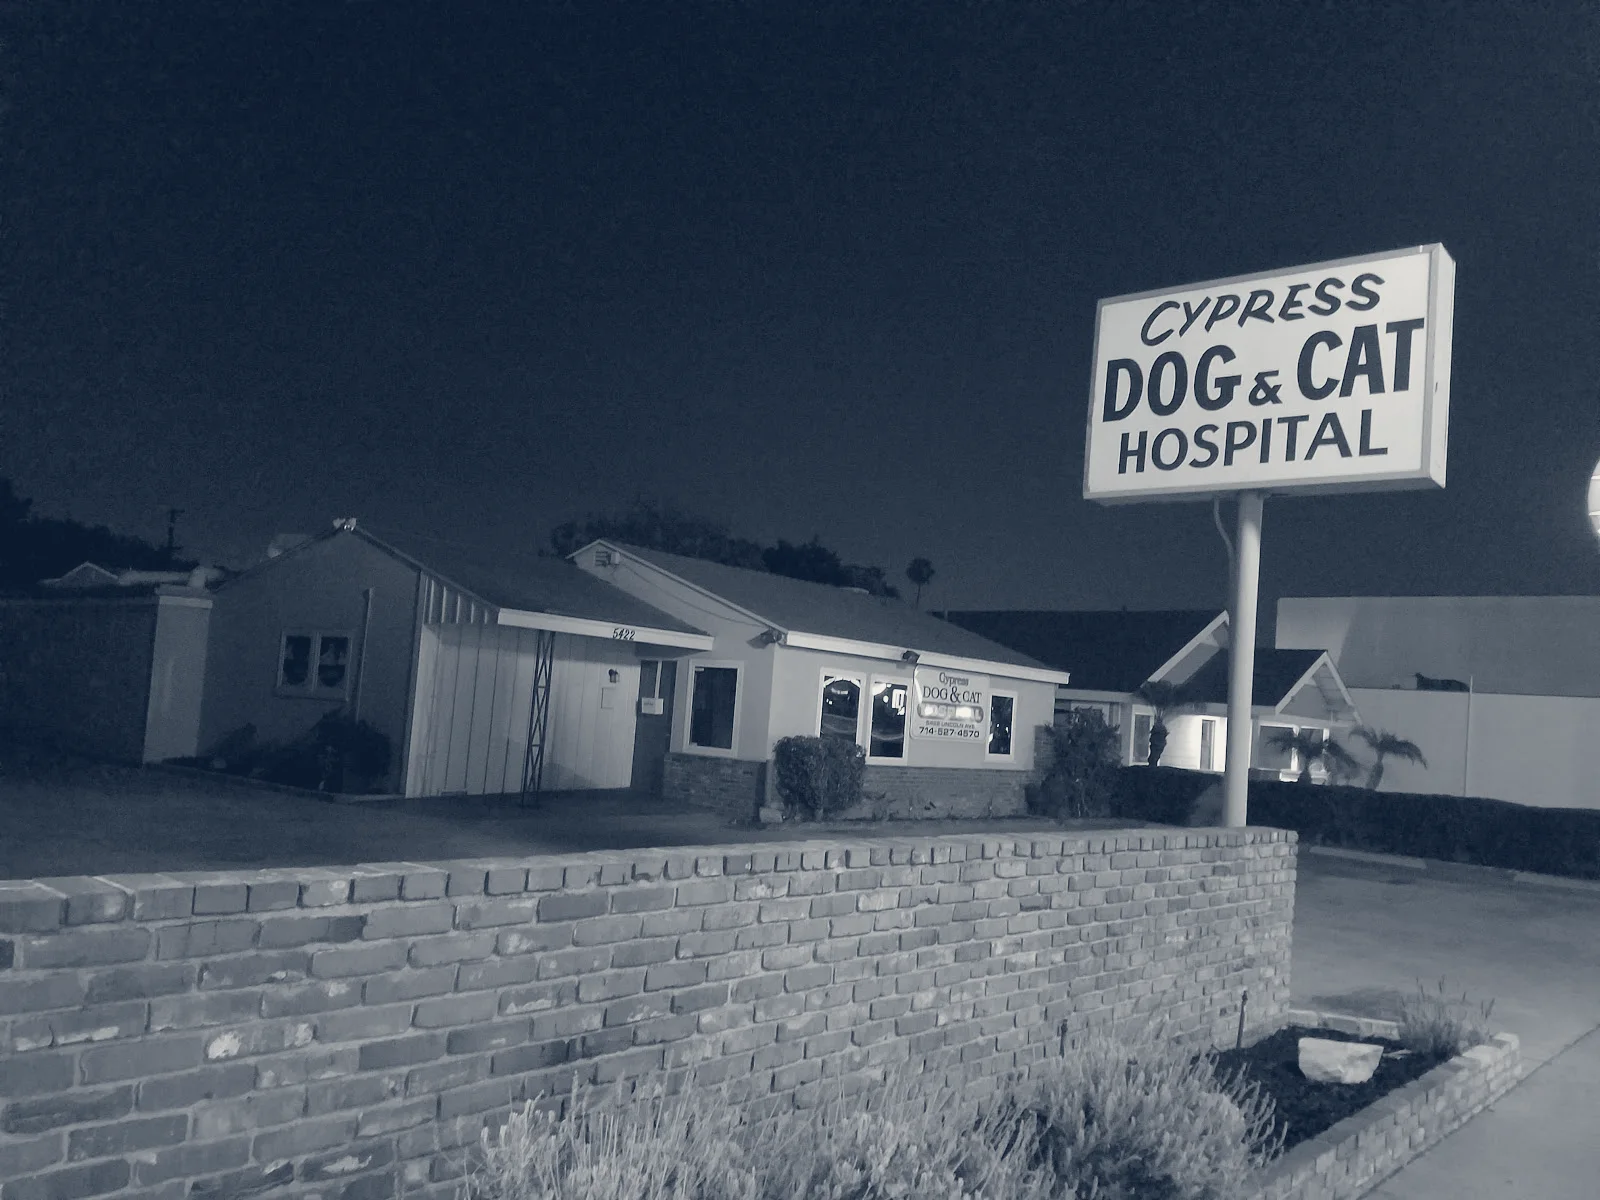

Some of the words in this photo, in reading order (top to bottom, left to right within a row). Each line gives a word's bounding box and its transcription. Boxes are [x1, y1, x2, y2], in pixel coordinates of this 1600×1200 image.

[1140, 272, 1386, 347] CYPRESS
[1102, 344, 1242, 423] DOG
[1248, 369, 1283, 407] &
[1296, 317, 1425, 401] CAT
[1117, 408, 1389, 475] HOSPITAL
[612, 627, 636, 641] 5422
[923, 686, 948, 701] DOG
[949, 686, 962, 704] &
[962, 690, 982, 704] CAT
[939, 672, 969, 687] Cypress
